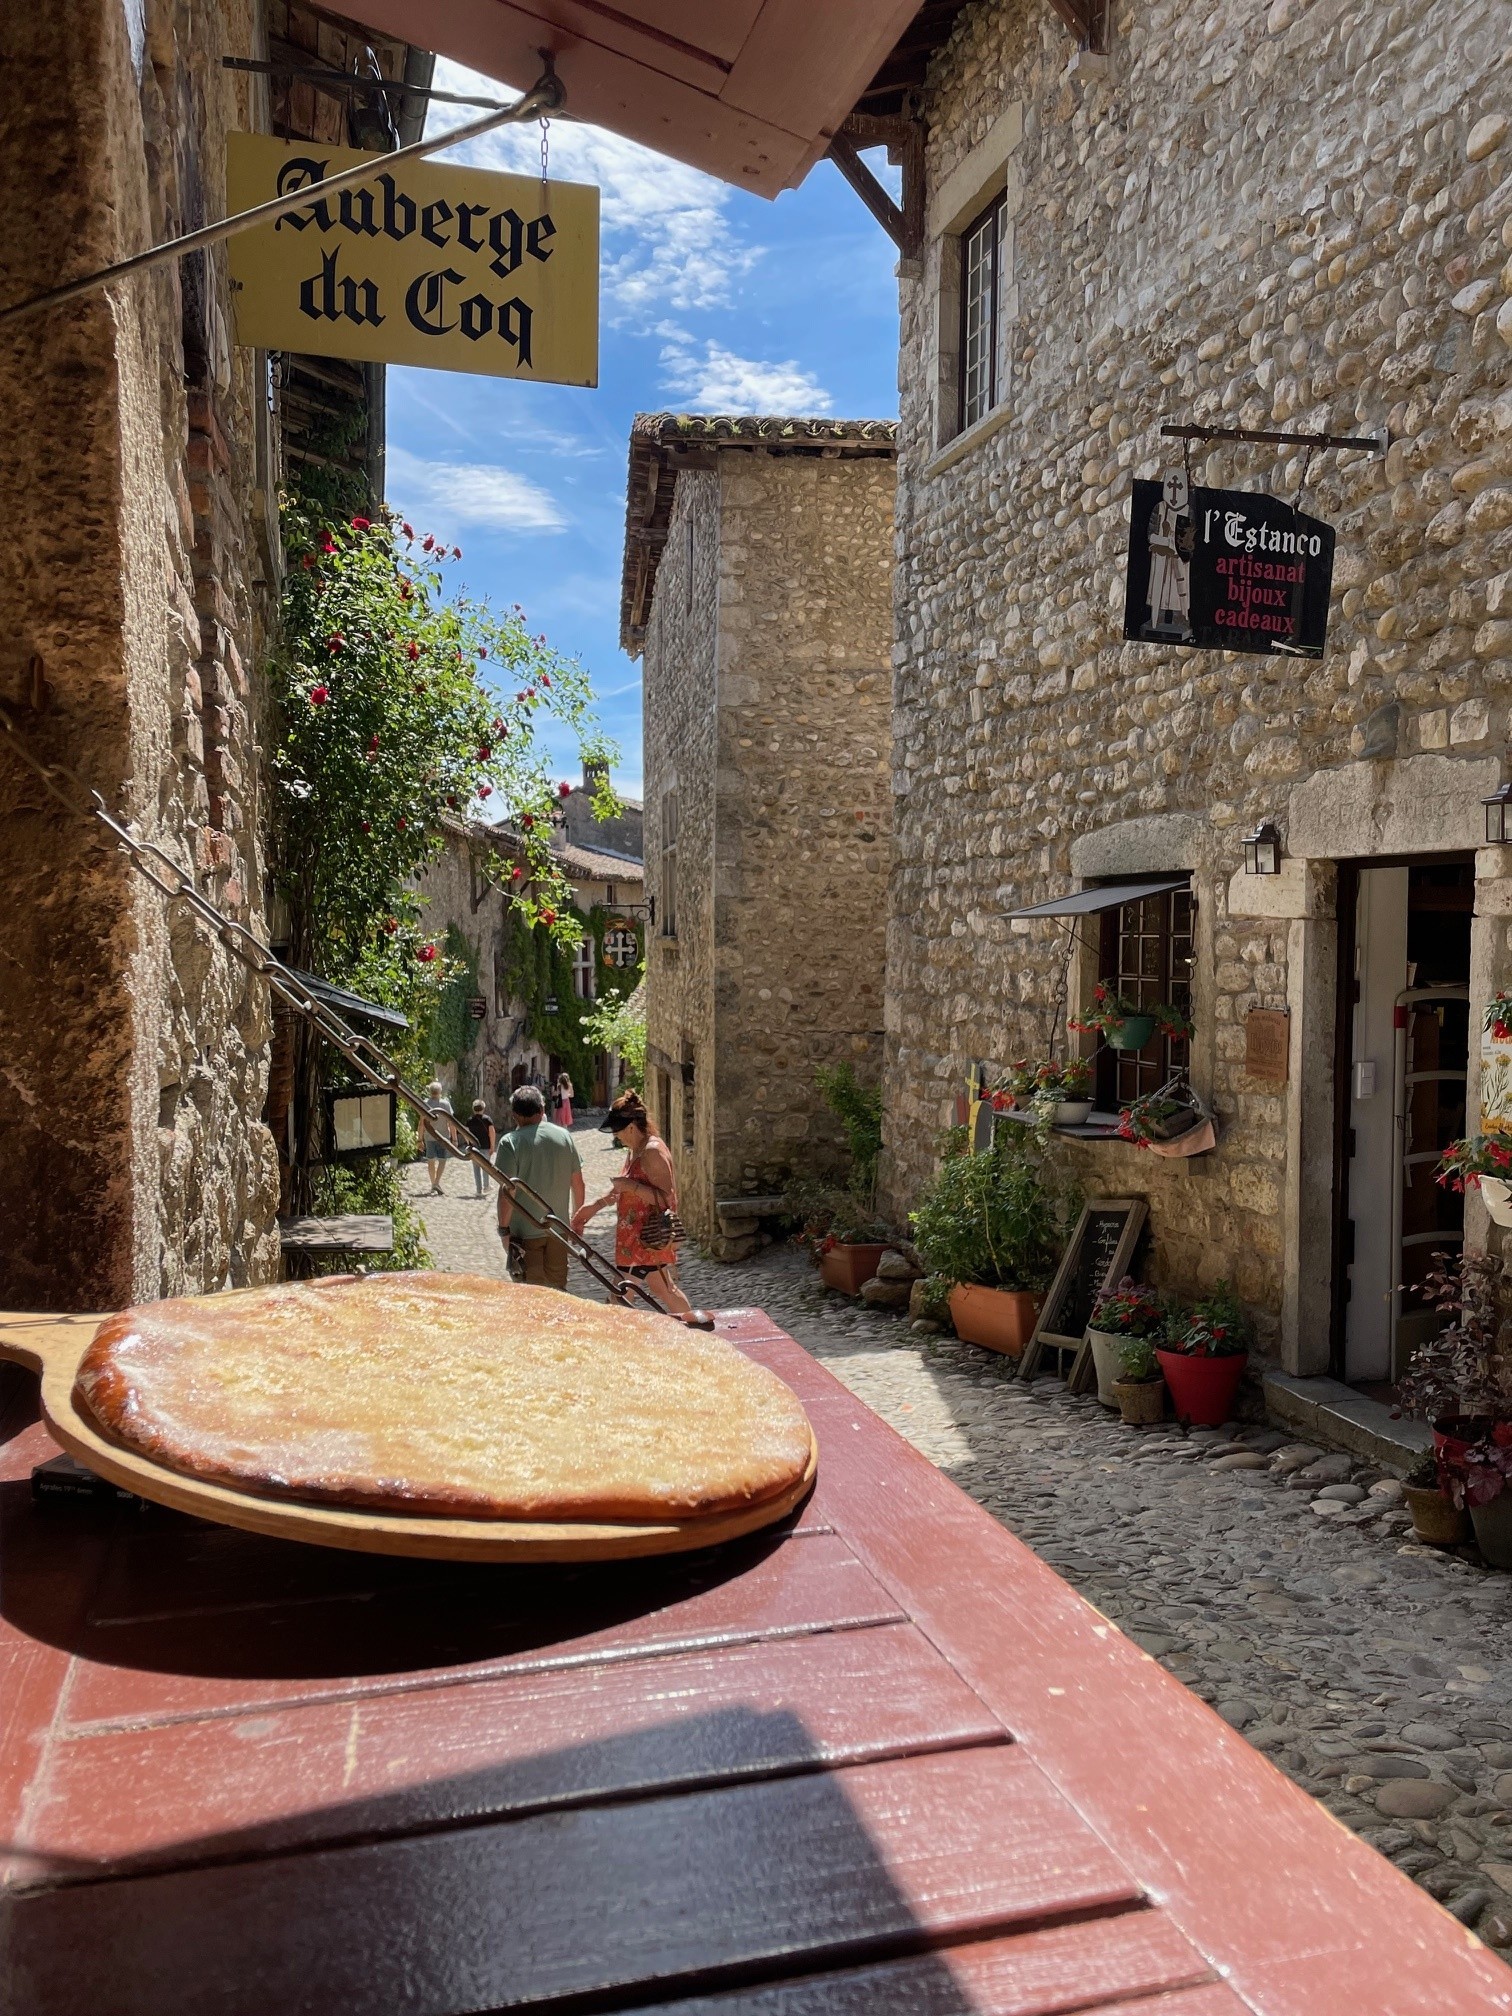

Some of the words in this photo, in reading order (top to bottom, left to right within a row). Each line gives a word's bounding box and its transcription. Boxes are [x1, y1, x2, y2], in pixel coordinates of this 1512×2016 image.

[274, 157, 558, 279] Auberge
[298, 243, 387, 328] du
[404, 267, 534, 370] Coq
[1203, 509, 1322, 557] l'Estanco
[1215, 554, 1306, 583] artisanat
[1227, 577, 1287, 608] bijoux
[1214, 607, 1296, 634] cadeaux
